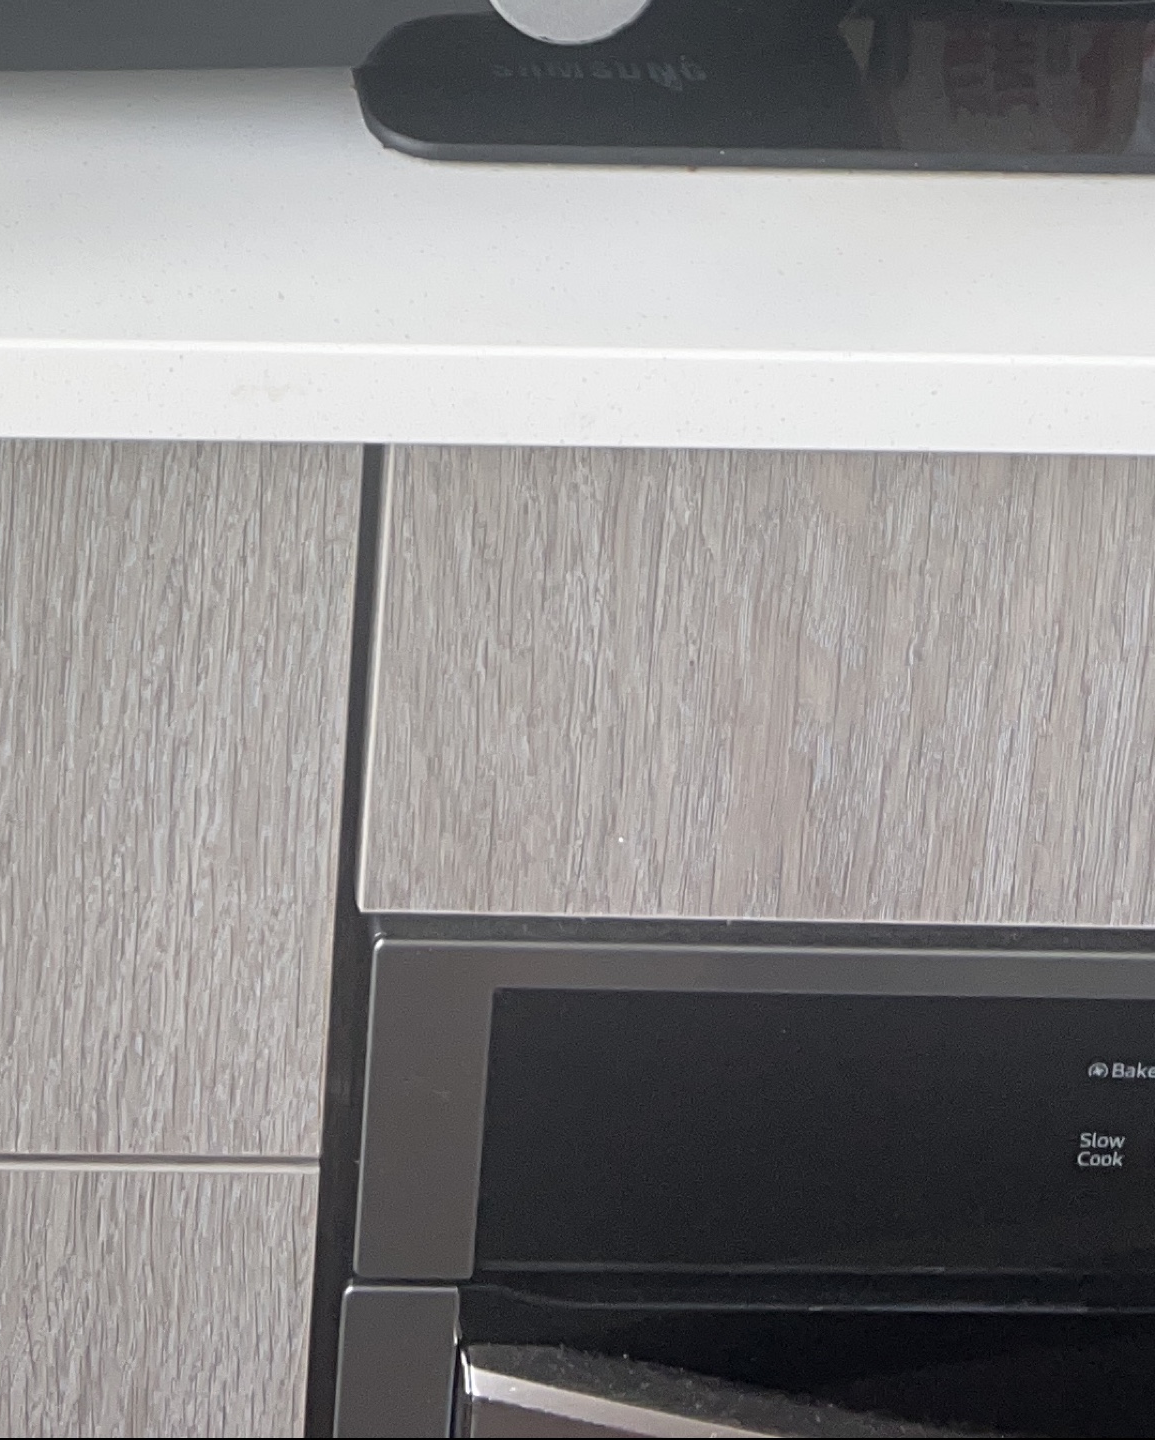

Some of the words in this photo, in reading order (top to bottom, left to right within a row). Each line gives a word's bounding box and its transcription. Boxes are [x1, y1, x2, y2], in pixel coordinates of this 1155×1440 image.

[1111, 1061, 1155, 1079] Bake
[1079, 1132, 1126, 1149] Slow
[1077, 1151, 1124, 1167] Cook
